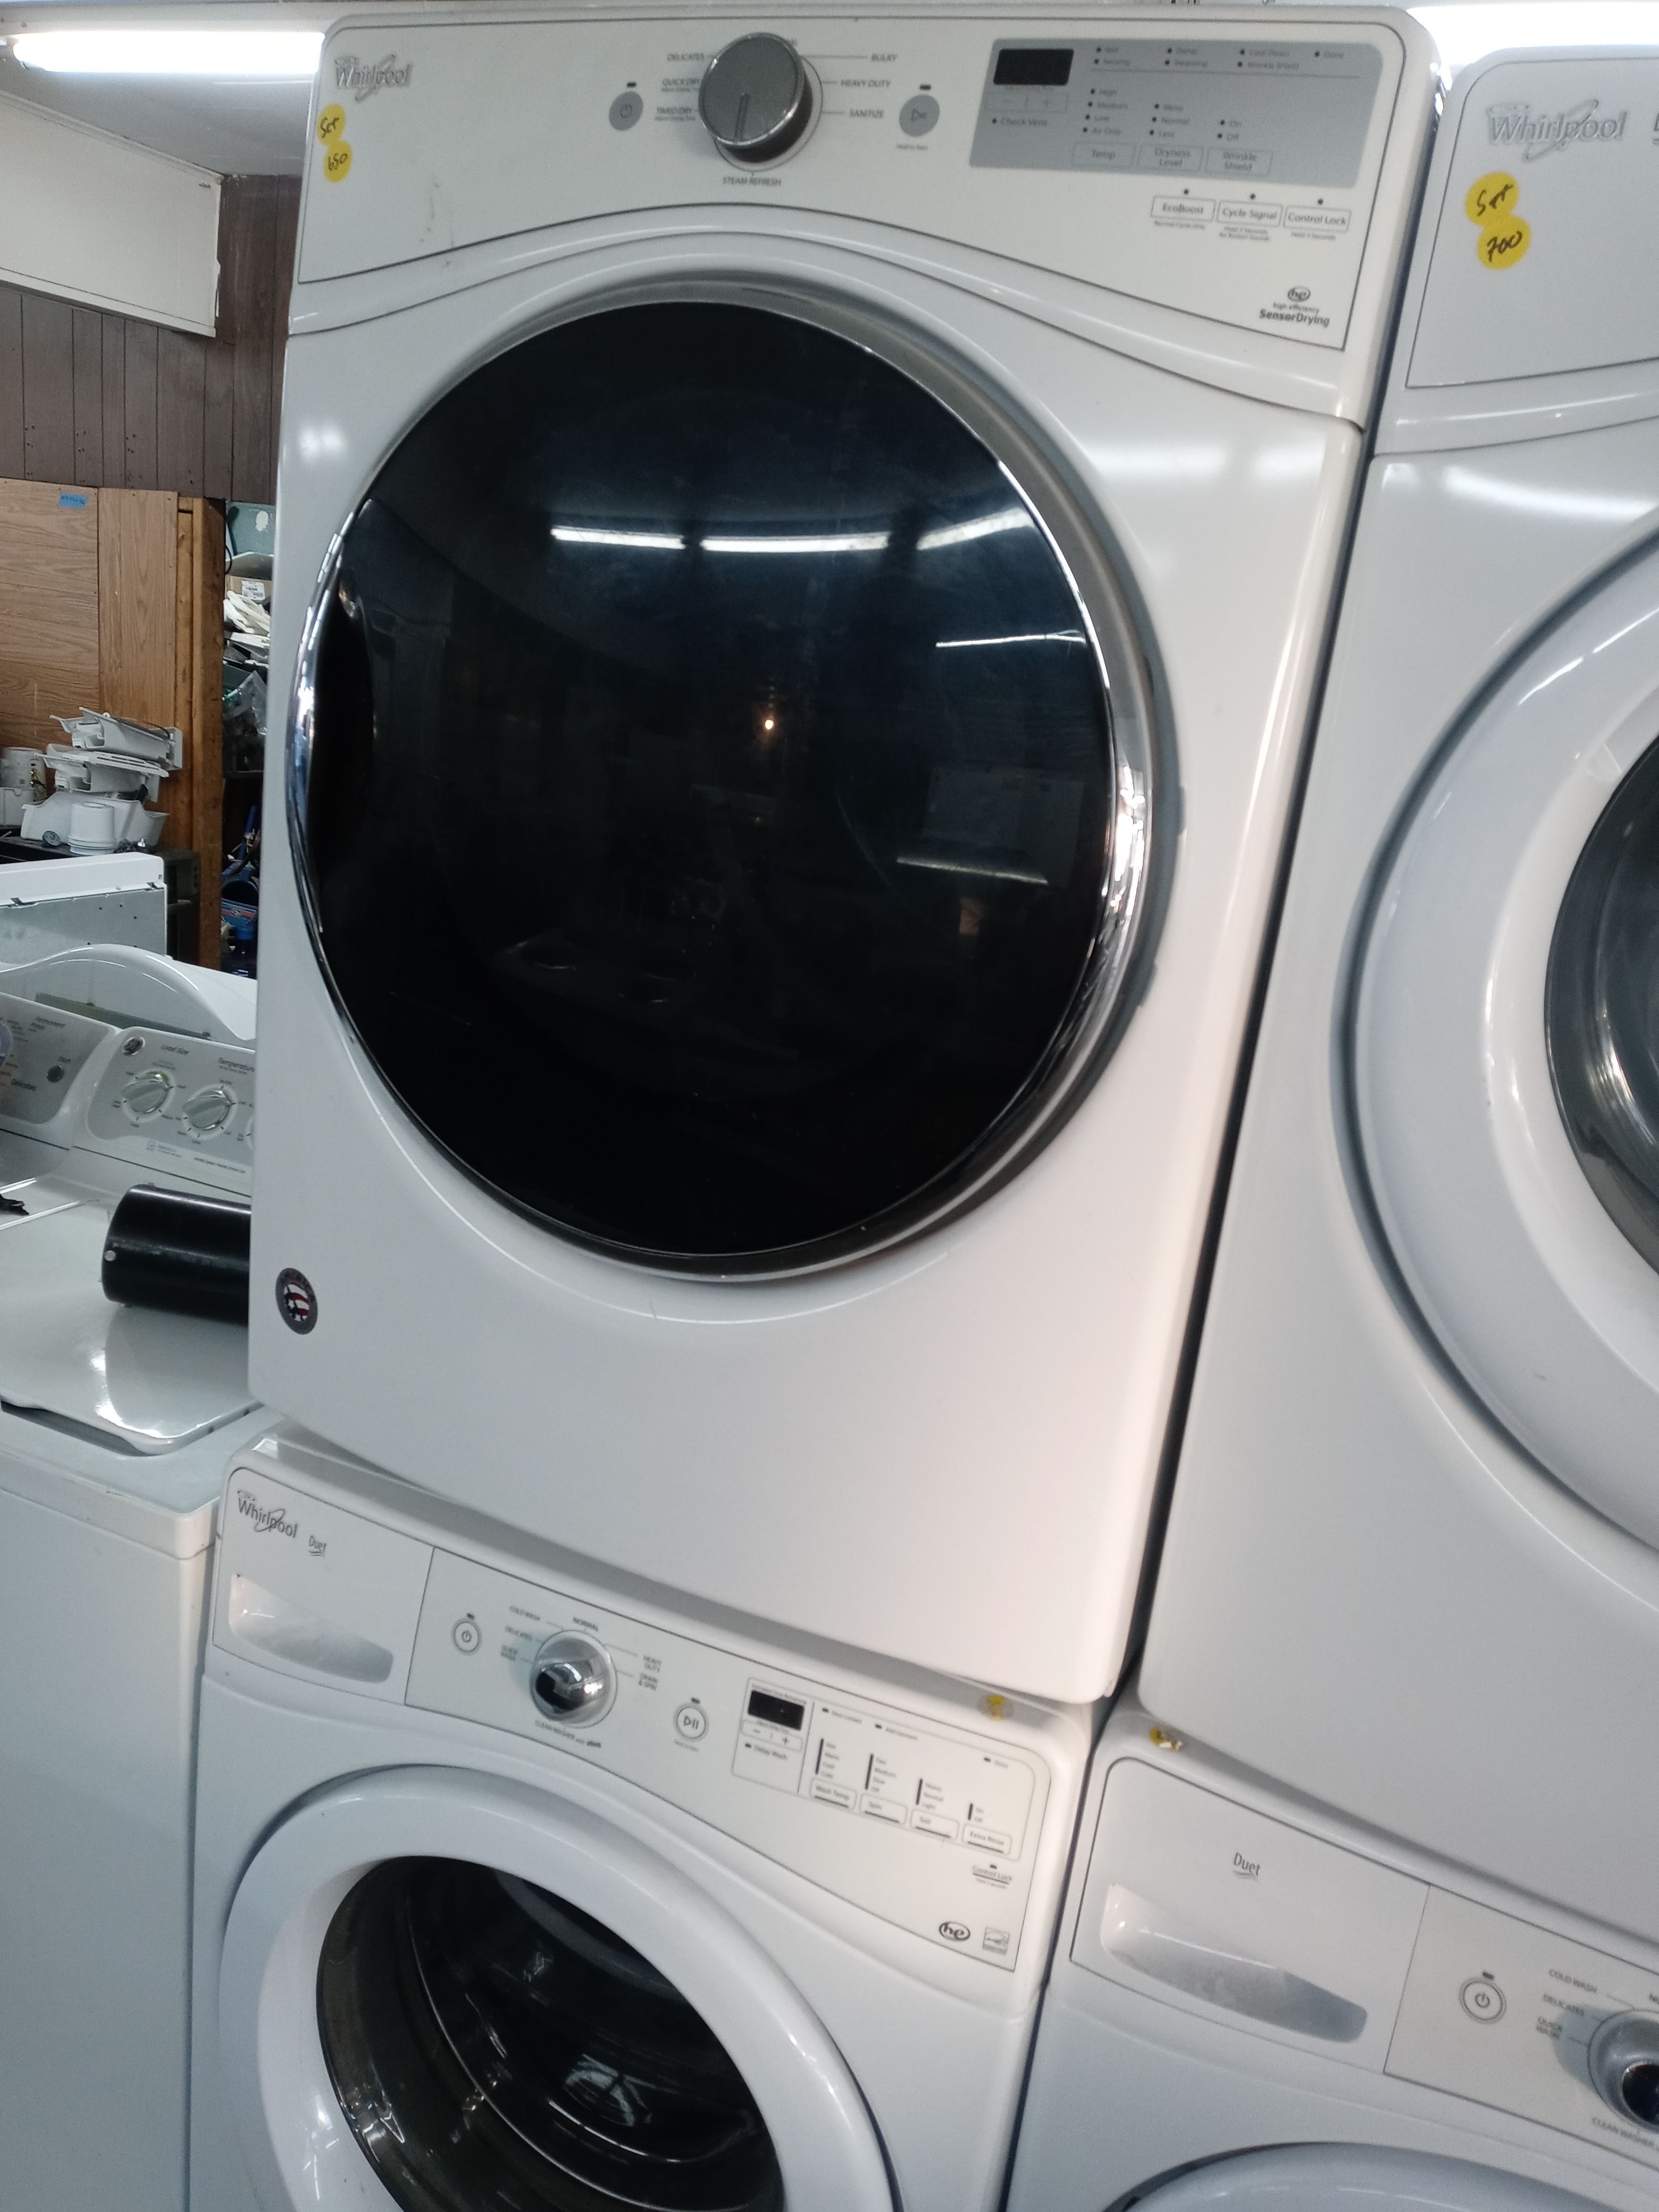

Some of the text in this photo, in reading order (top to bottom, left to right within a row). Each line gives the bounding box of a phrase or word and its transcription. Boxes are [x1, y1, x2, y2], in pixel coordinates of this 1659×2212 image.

[871, 54, 897, 62] BULKY
[336, 58, 413, 97] Whirlpool
[841, 79, 891, 88] HEAVY DUTY
[849, 109, 885, 119] SANITIZE
[1487, 104, 1628, 155] Whirlpool
[328, 153, 348, 172] 650
[723, 176, 782, 187] STEAM REFRESH
[1162, 203, 1204, 214] EcoBoost
[1222, 207, 1277, 221] Cycle Signal
[1288, 213, 1346, 225] Control Lock
[1487, 231, 1523, 262] 700
[1259, 308, 1330, 328] SensorDrying
[237, 1493, 298, 1538] Whirlpool
[308, 1535, 326, 1553] Duet
[1234, 1852, 1260, 1876] Duet
[942, 1922, 967, 1941] he
[1548, 1968, 1597, 1994] COLD WASH
[1543, 1993, 1585, 2016] DELICATES
